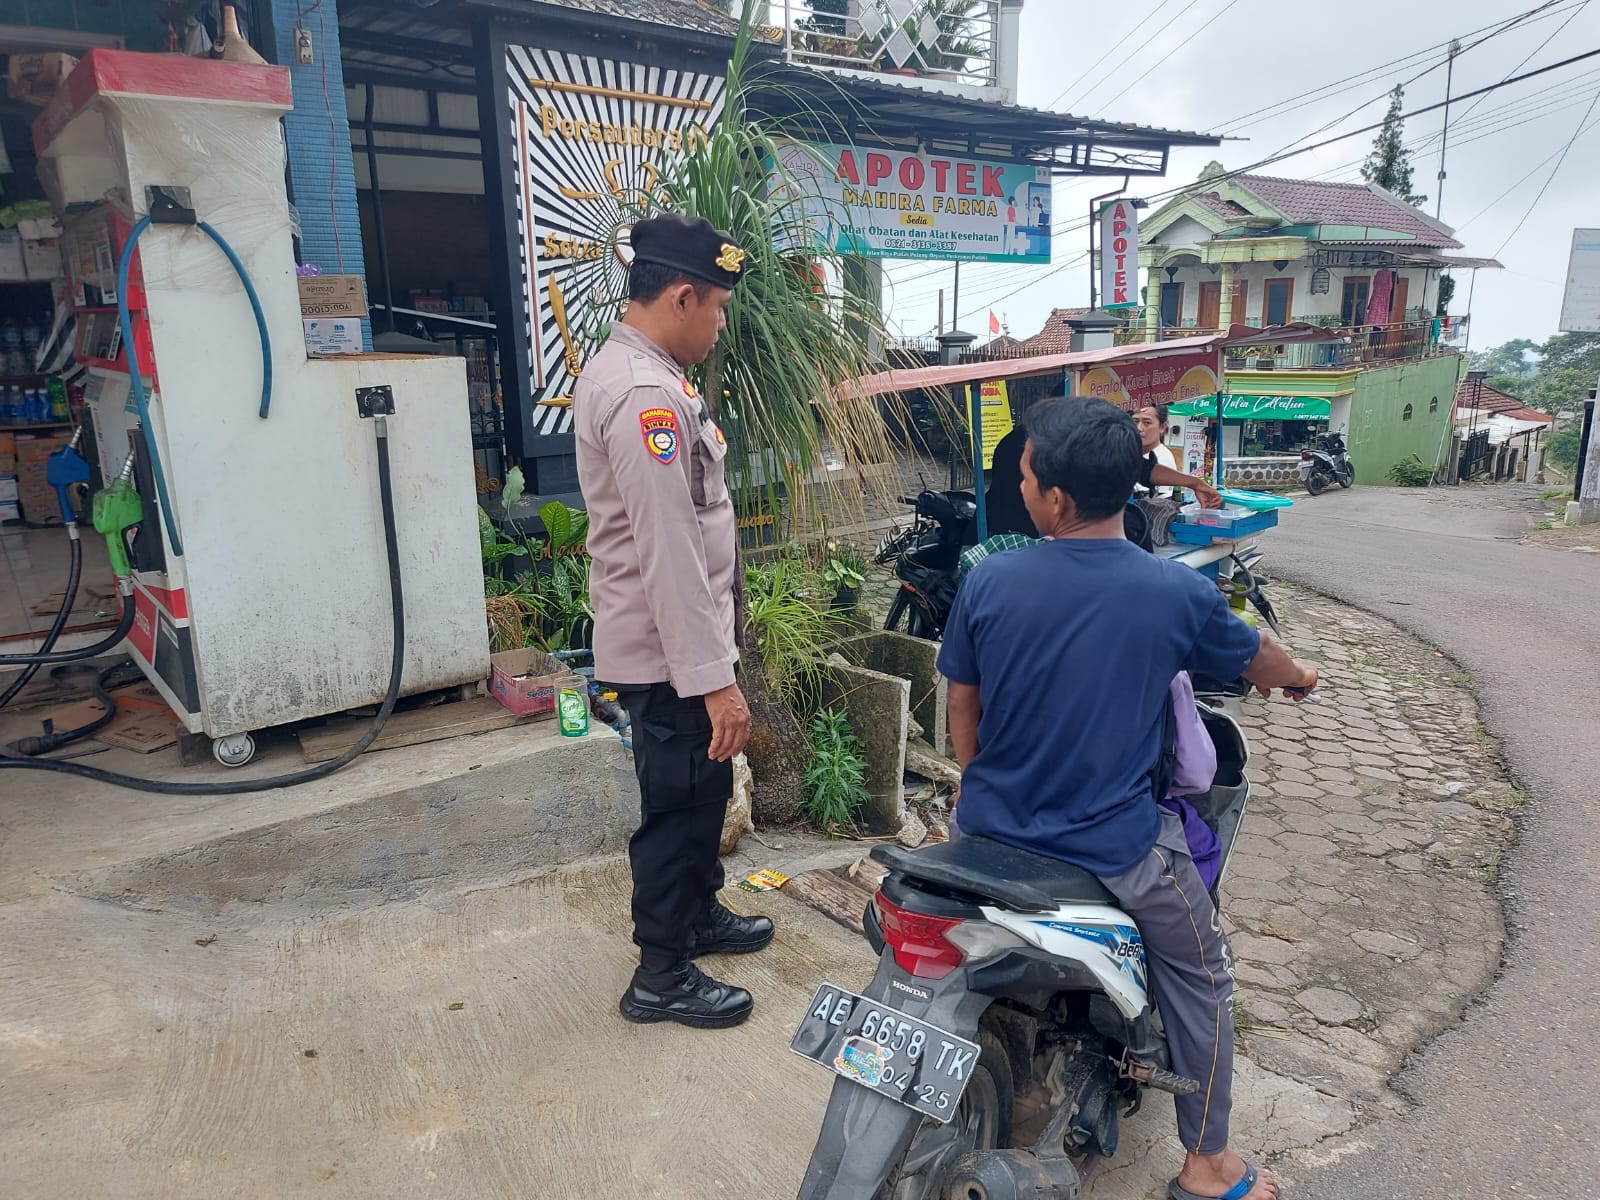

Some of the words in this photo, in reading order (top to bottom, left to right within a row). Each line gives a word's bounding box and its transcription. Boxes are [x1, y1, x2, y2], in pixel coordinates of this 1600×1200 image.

[834, 149, 1004, 198] APOTEK
[842, 189, 925, 212] MAHIRA
[933, 196, 998, 217] FARMA
[905, 213, 929, 226] Sedia
[868, 226, 906, 237] Obatan
[908, 228, 927, 238] dan
[929, 230, 949, 239] Alat
[951, 231, 999, 242] Kesehatan
[1113, 203, 1128, 304] APOTEK
[1090, 376, 1123, 396] Pentol
[1113, 393, 1142, 411] entol
[892, 980, 929, 999] HONDA
[812, 991, 851, 1026] AE
[861, 1010, 926, 1058] 6658
[934, 1040, 972, 1081] TK
